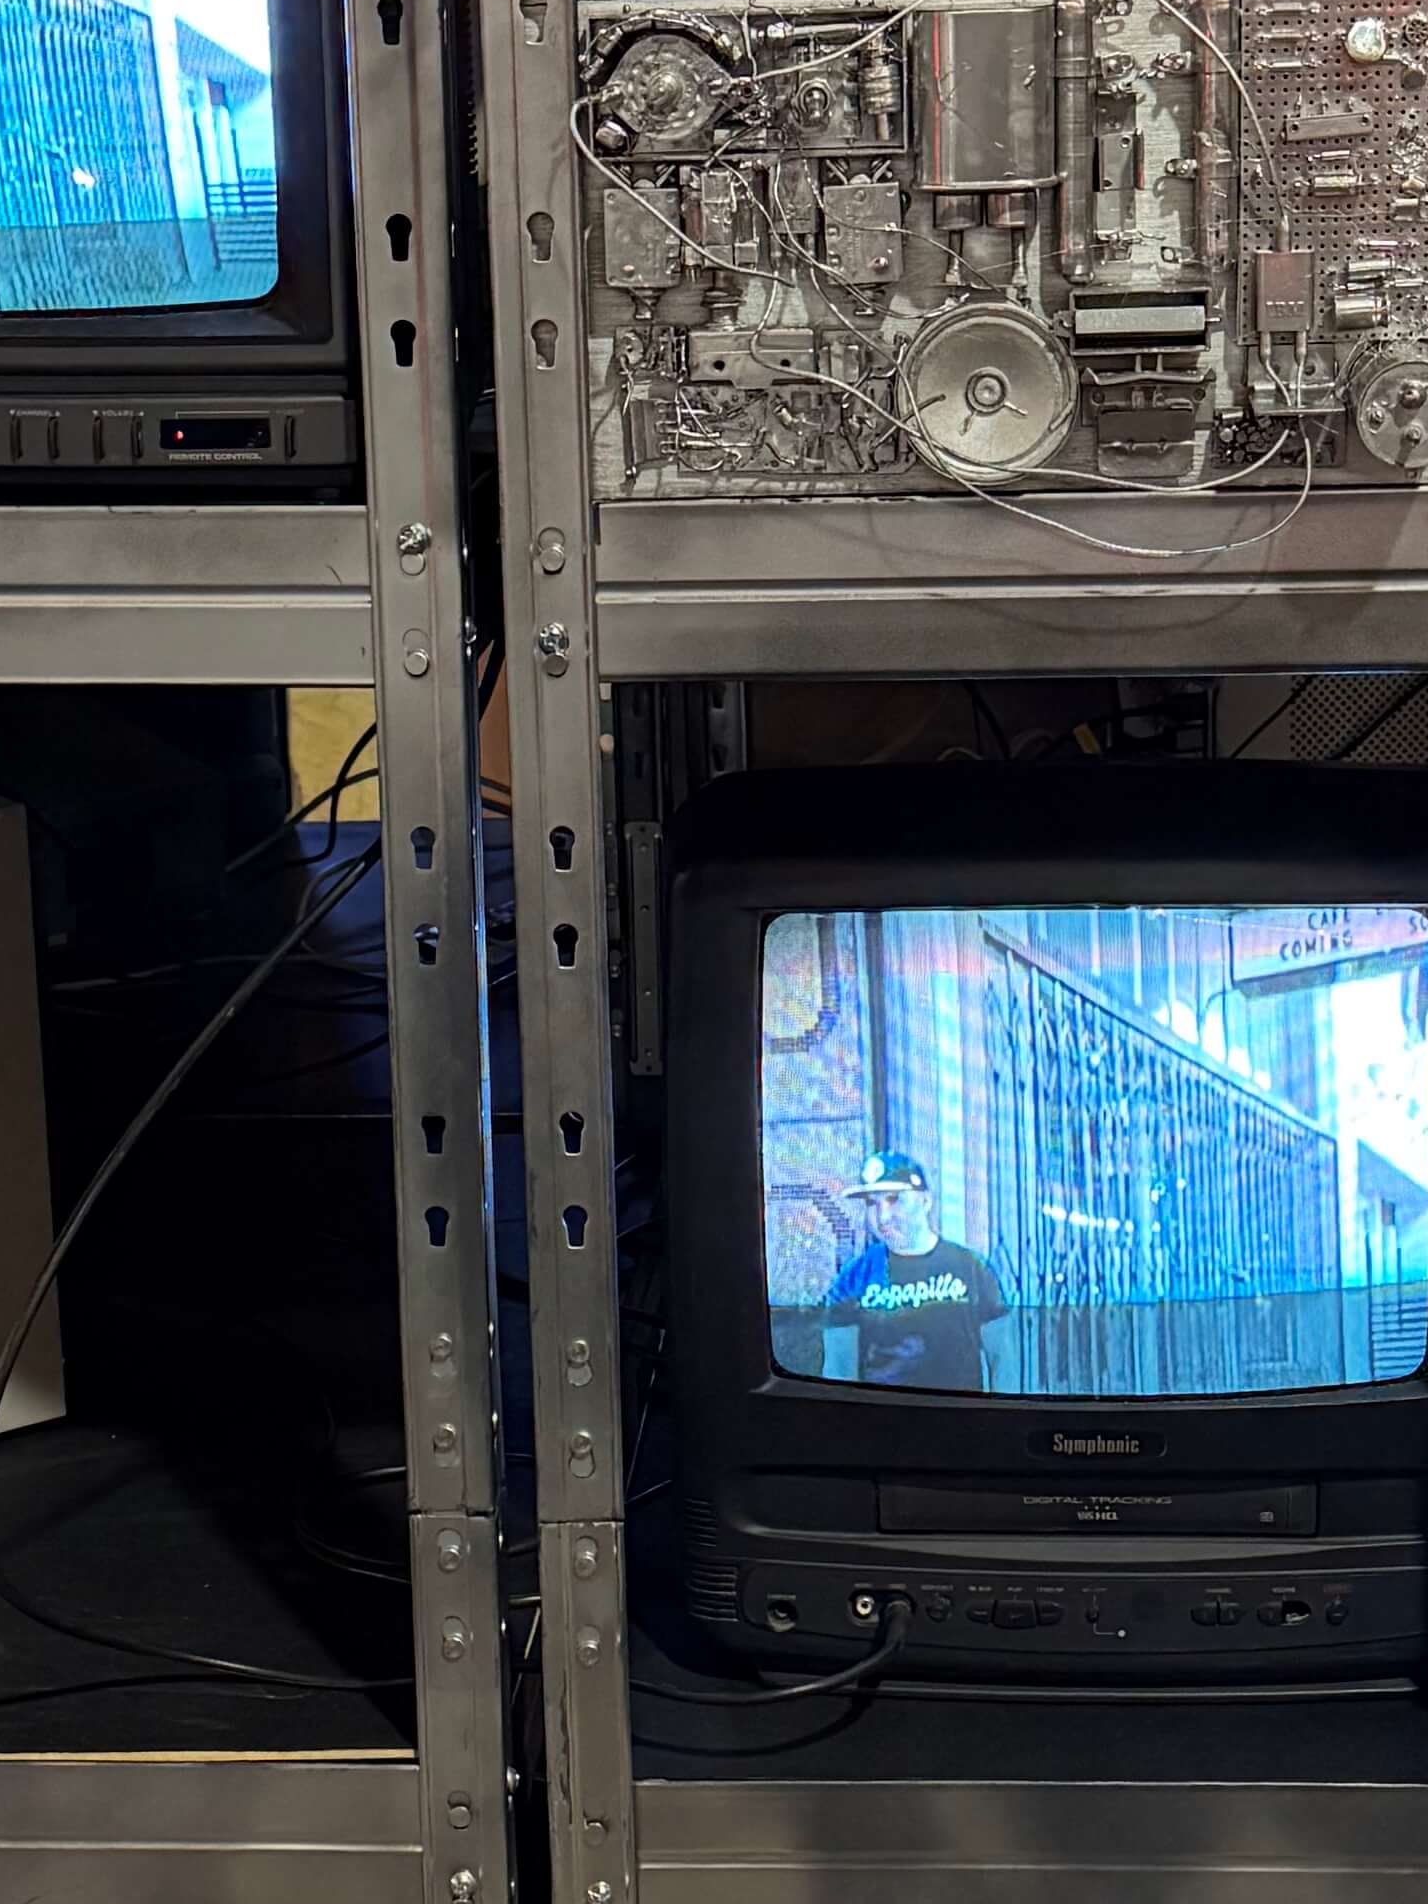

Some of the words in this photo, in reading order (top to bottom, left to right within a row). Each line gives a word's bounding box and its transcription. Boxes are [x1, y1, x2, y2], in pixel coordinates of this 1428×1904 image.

[1052, 1433, 1140, 1456] Symphonic
[1023, 1496, 1083, 1505] DIGITAL
[1090, 1495, 1173, 1505] TRACKING
